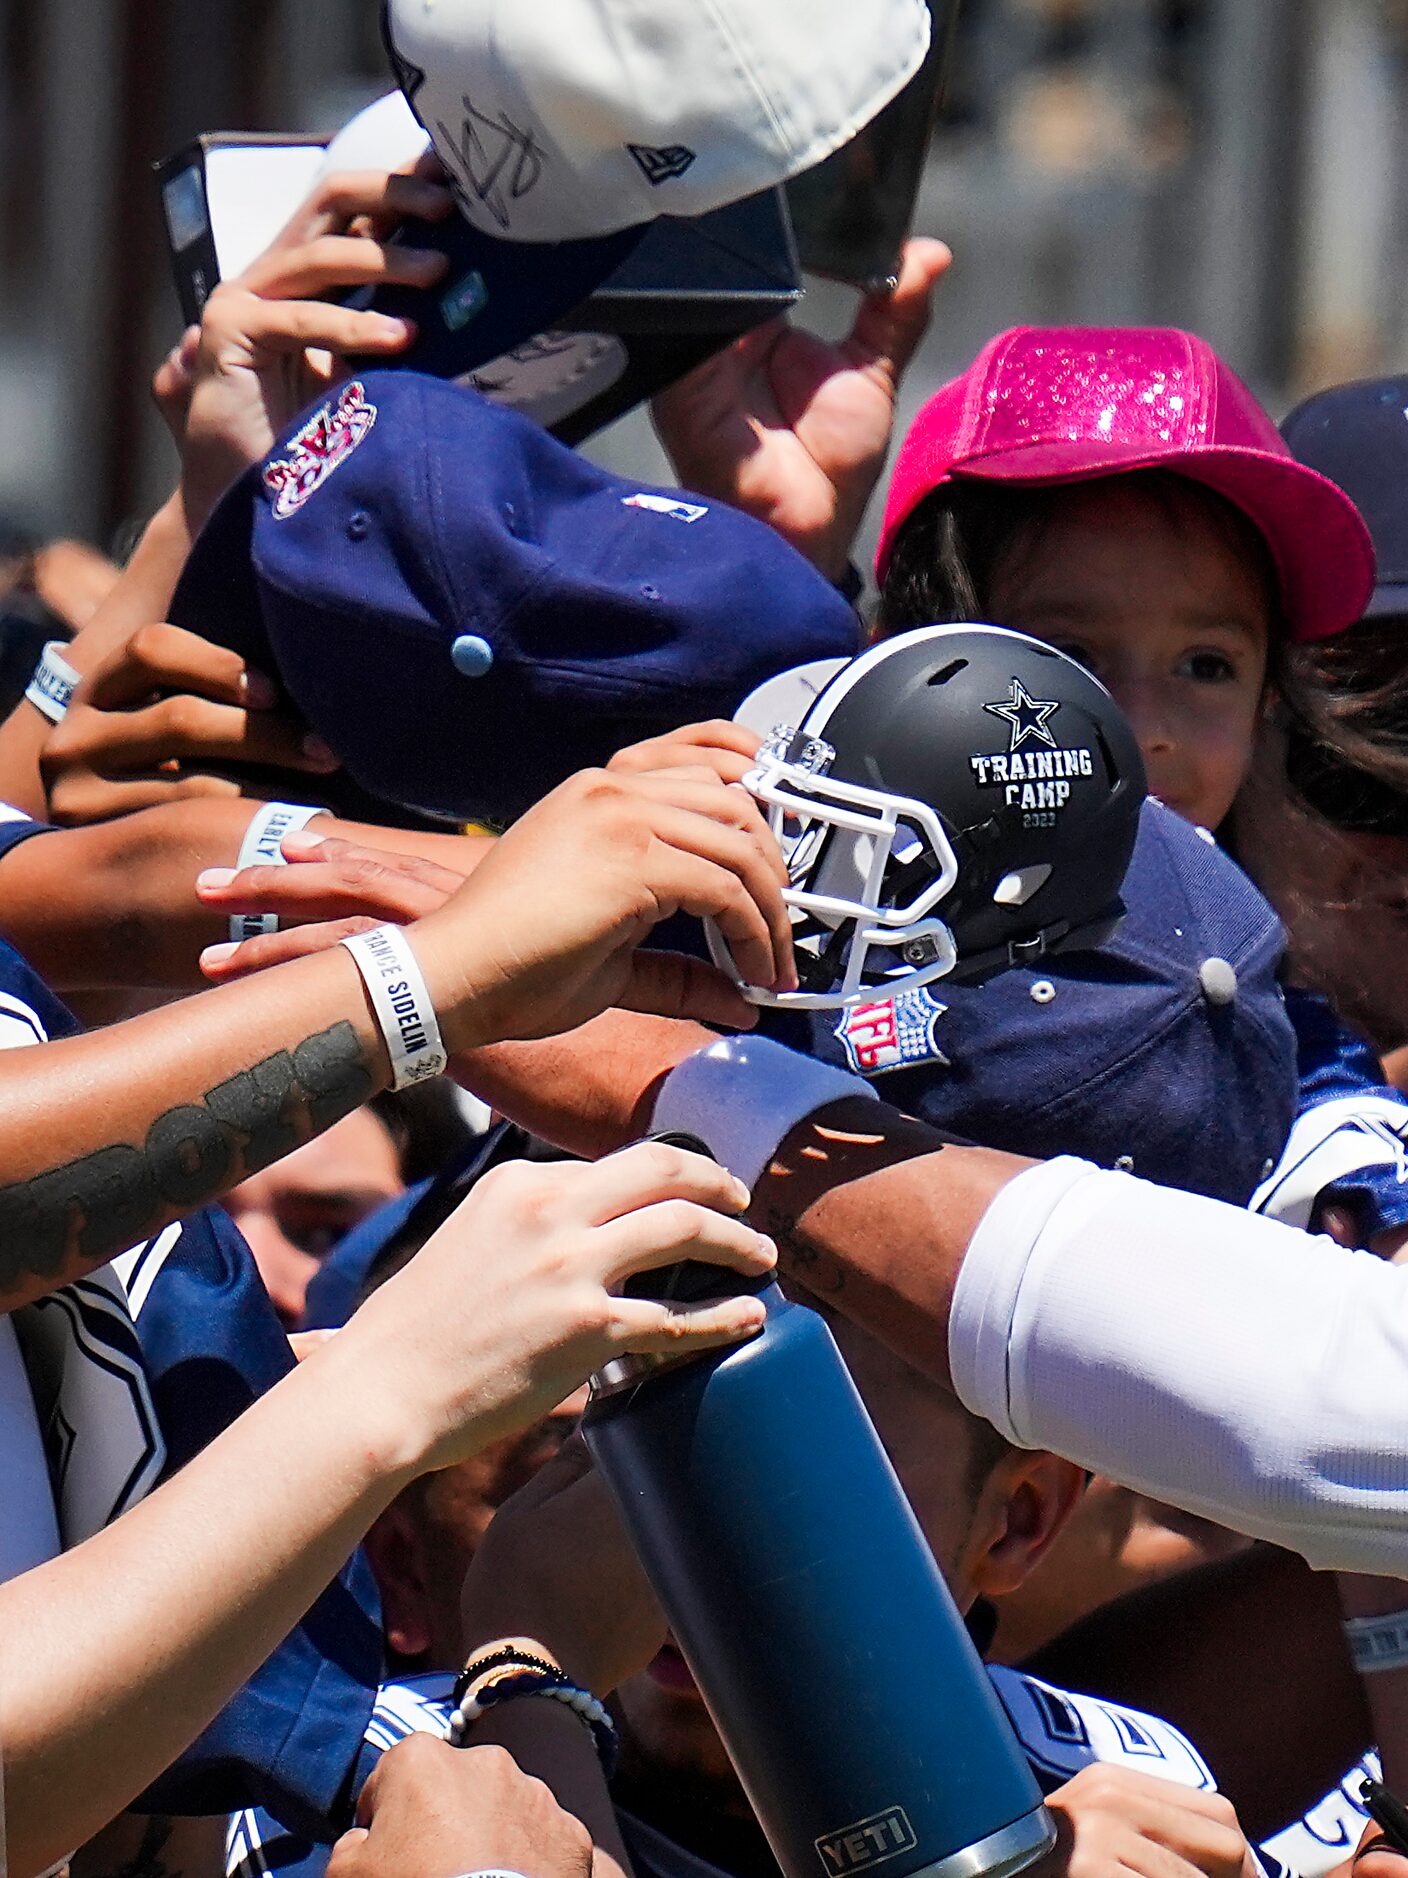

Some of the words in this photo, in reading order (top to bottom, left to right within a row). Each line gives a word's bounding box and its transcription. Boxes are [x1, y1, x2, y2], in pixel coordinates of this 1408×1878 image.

[971, 749, 1093, 784] TRAINING
[1005, 780, 1071, 809] CAMP
[821, 1817, 906, 1868] YETI
